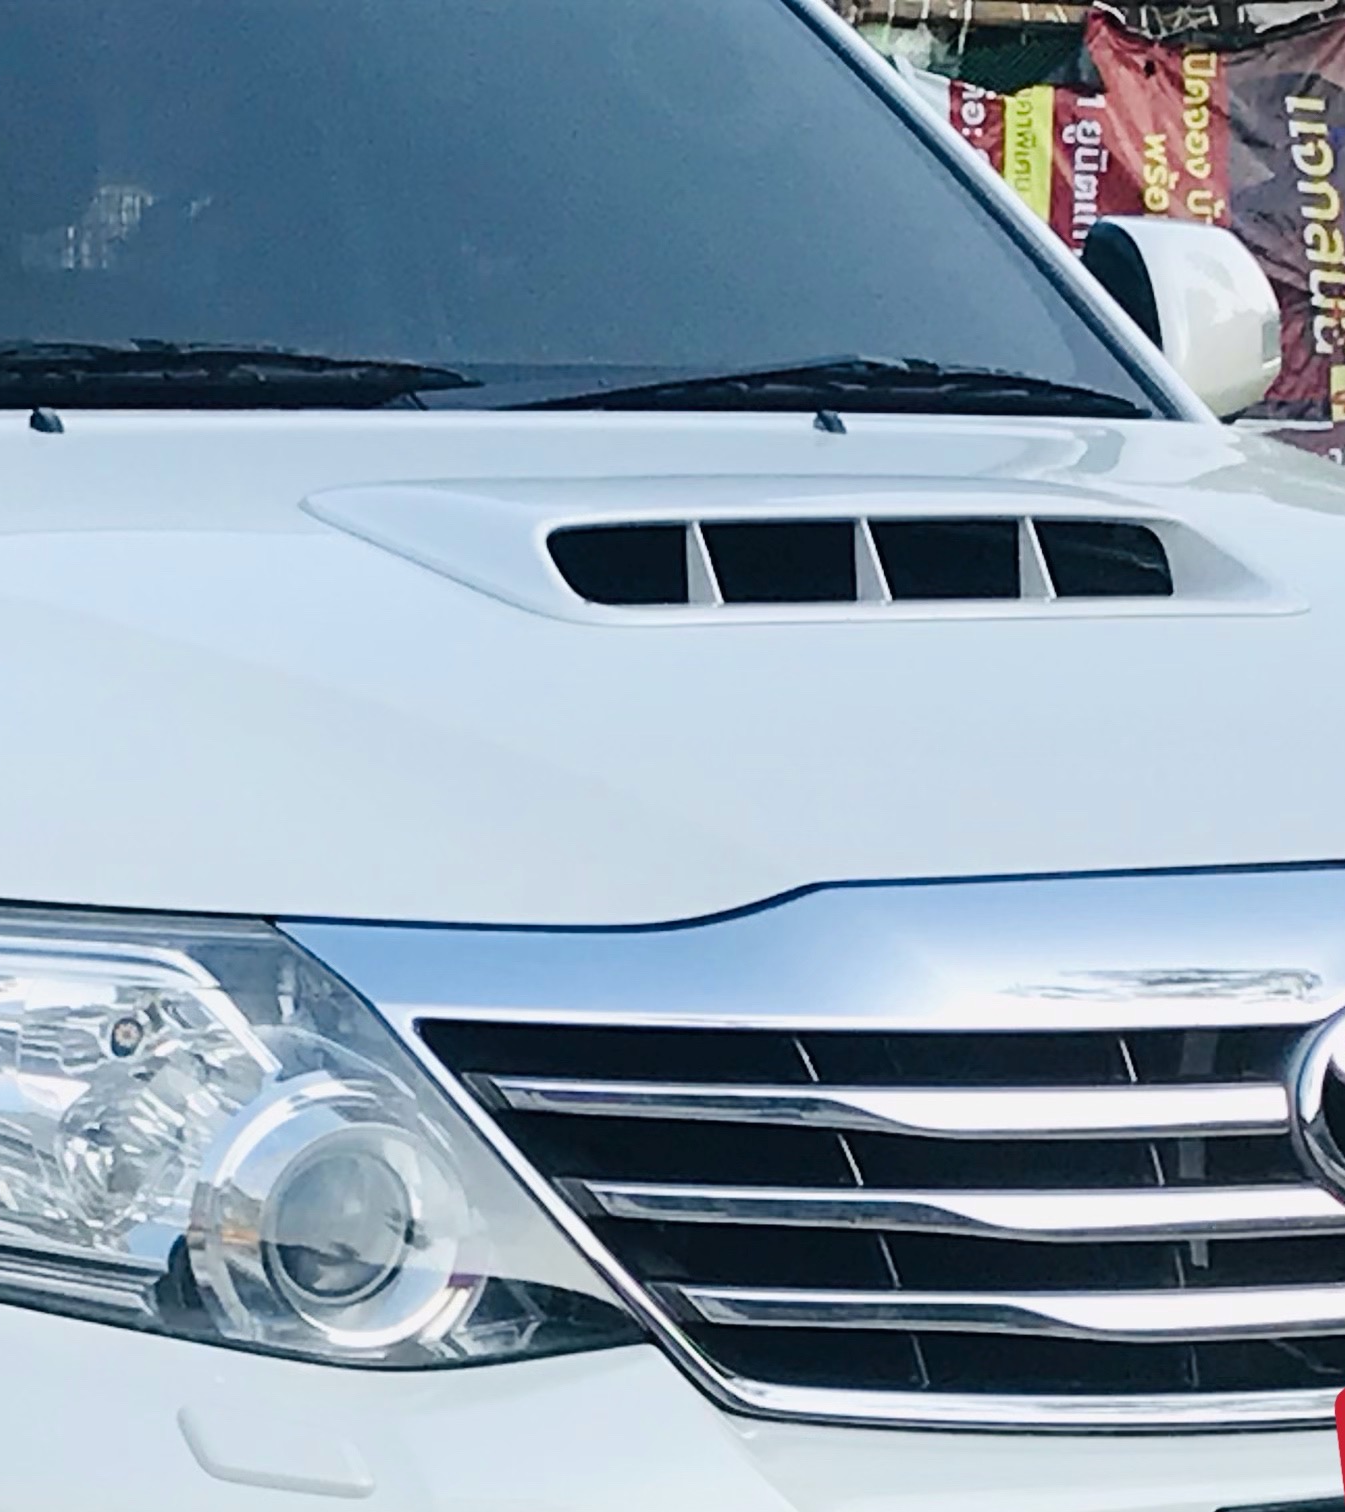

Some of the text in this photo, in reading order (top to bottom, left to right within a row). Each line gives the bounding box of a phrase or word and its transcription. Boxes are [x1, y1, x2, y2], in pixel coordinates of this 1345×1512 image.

[1181, 51, 1218, 179] ปิดจอง
[1143, 132, 1180, 218] พร้อ
